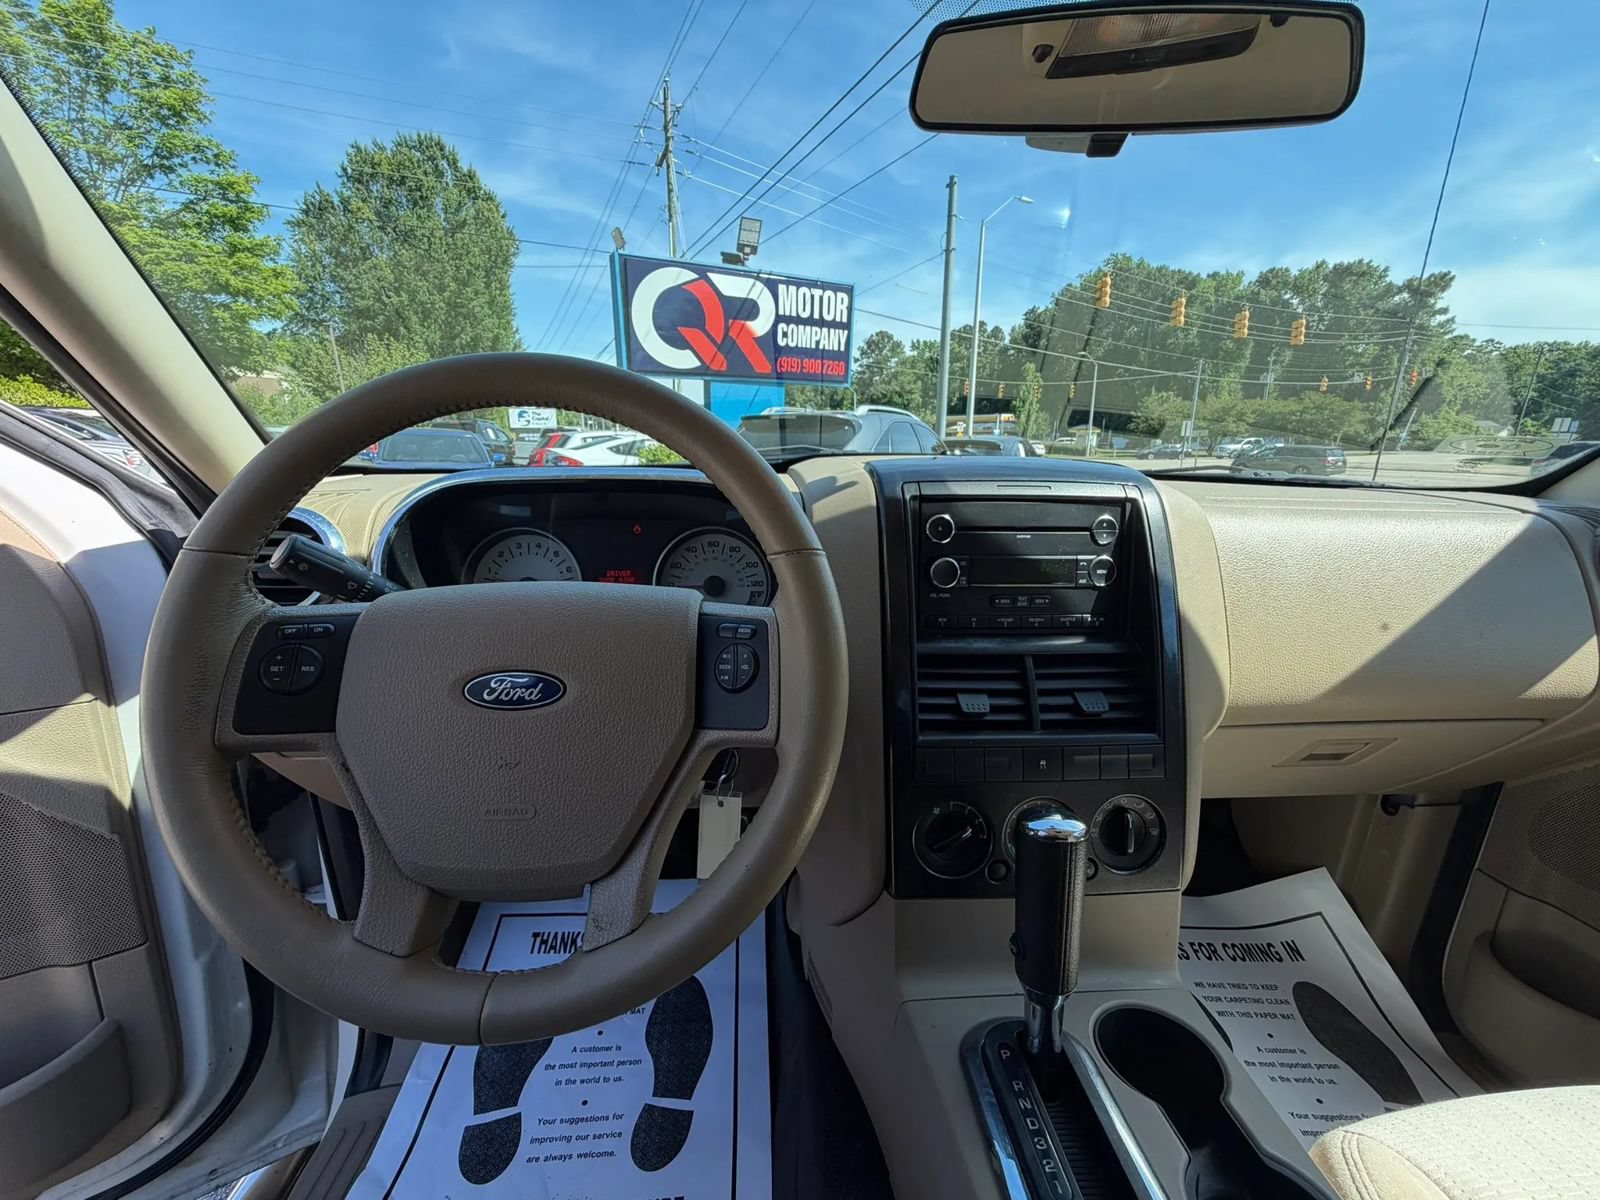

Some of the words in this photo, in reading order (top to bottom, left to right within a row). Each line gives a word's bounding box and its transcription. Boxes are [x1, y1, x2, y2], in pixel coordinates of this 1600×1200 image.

[777, 283, 848, 323] MOTOR
[777, 322, 848, 352] COMPANY
[776, 356, 801, 374] (919)
[708, 540, 720, 548] 60
[745, 561, 759, 569] 100
[483, 676, 544, 701] Ford
[1188, 941, 1225, 962] FOR
[1221, 939, 1284, 963] COMING
[1280, 939, 1307, 962] IN
[1193, 981, 1206, 989] WE
[1206, 981, 1226, 990] HAVE
[1226, 982, 1248, 991] TRIED
[1248, 983, 1259, 991] TO
[1260, 983, 1279, 991] KEEP
[1202, 995, 1222, 1003] YOUR
[1224, 996, 1266, 1005] CARPETING
[1266, 997, 1291, 1006] CLEAN
[1216, 1010, 1236, 1018] WITH
[1237, 1010, 1254, 1019] THIS
[1255, 1011, 1278, 1020] PAPER
[1279, 1013, 1296, 1021] MAT
[571, 1046, 578, 1054] A
[579, 1044, 613, 1053] customer
[1256, 1046, 1263, 1054] A
[1263, 1046, 1298, 1055] customer
[1299, 1047, 1307, 1055] is
[544, 1063, 556, 1071] the
[558, 1061, 577, 1070] most
[579, 1060, 615, 1070] important
[615, 1058, 642, 1068] person
[1243, 1059, 1257, 1068] the
[1258, 1060, 1277, 1069] most
[1277, 1061, 1314, 1071] important
[1313, 1063, 1341, 1072] person
[554, 1078, 563, 1087] in
[564, 1077, 577, 1086] the
[579, 1076, 601, 1085] world
[613, 1075, 625, 1083] us.
[1268, 1075, 1278, 1083] in
[1278, 1075, 1292, 1084] the
[1292, 1076, 1315, 1085] world
[1315, 1077, 1325, 1085] to
[1326, 1078, 1339, 1086] us.
[537, 1117, 557, 1126] Your
[559, 1114, 610, 1126] suggestions
[612, 1112, 625, 1121] for
[1000, 1050, 1011, 1060] P
[1012, 1080, 1024, 1092] R
[1019, 1097, 1033, 1110] N
[1026, 1117, 1040, 1130] D
[1034, 1136, 1048, 1149] 3
[1043, 1159, 1057, 1173] 2
[1053, 1180, 1064, 1195] 1
[1288, 1111, 1310, 1120] Your
[1311, 1113, 1362, 1122] suggestions
[529, 1134, 573, 1146] improving
[592, 1131, 623, 1140] service
[526, 1156, 541, 1164] are
[543, 1153, 573, 1164] always
[576, 1149, 617, 1159] welcome.
